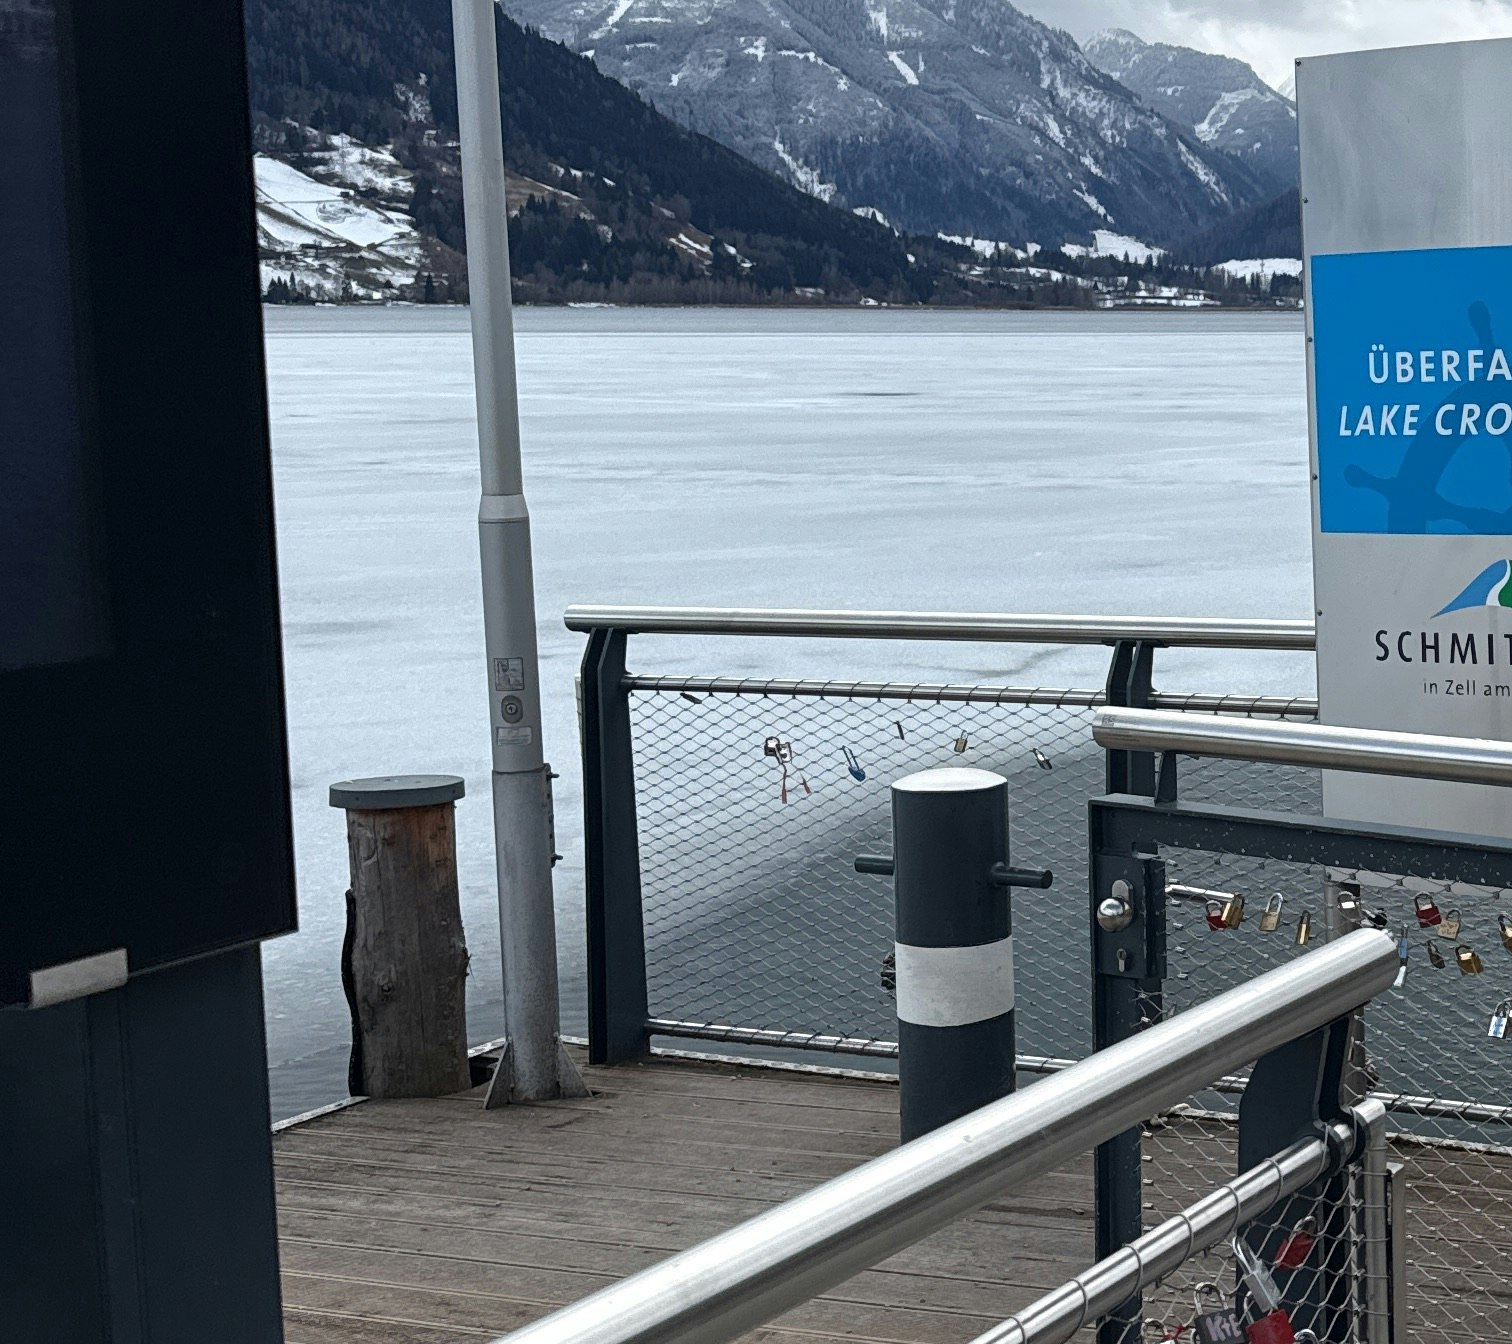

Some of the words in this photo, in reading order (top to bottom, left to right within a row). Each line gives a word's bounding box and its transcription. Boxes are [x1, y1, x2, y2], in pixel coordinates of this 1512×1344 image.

[1339, 404, 1421, 438] LAKE
[1422, 678, 1439, 695] in
[1444, 679, 1477, 696] Zell
[1483, 684, 1511, 698] am
